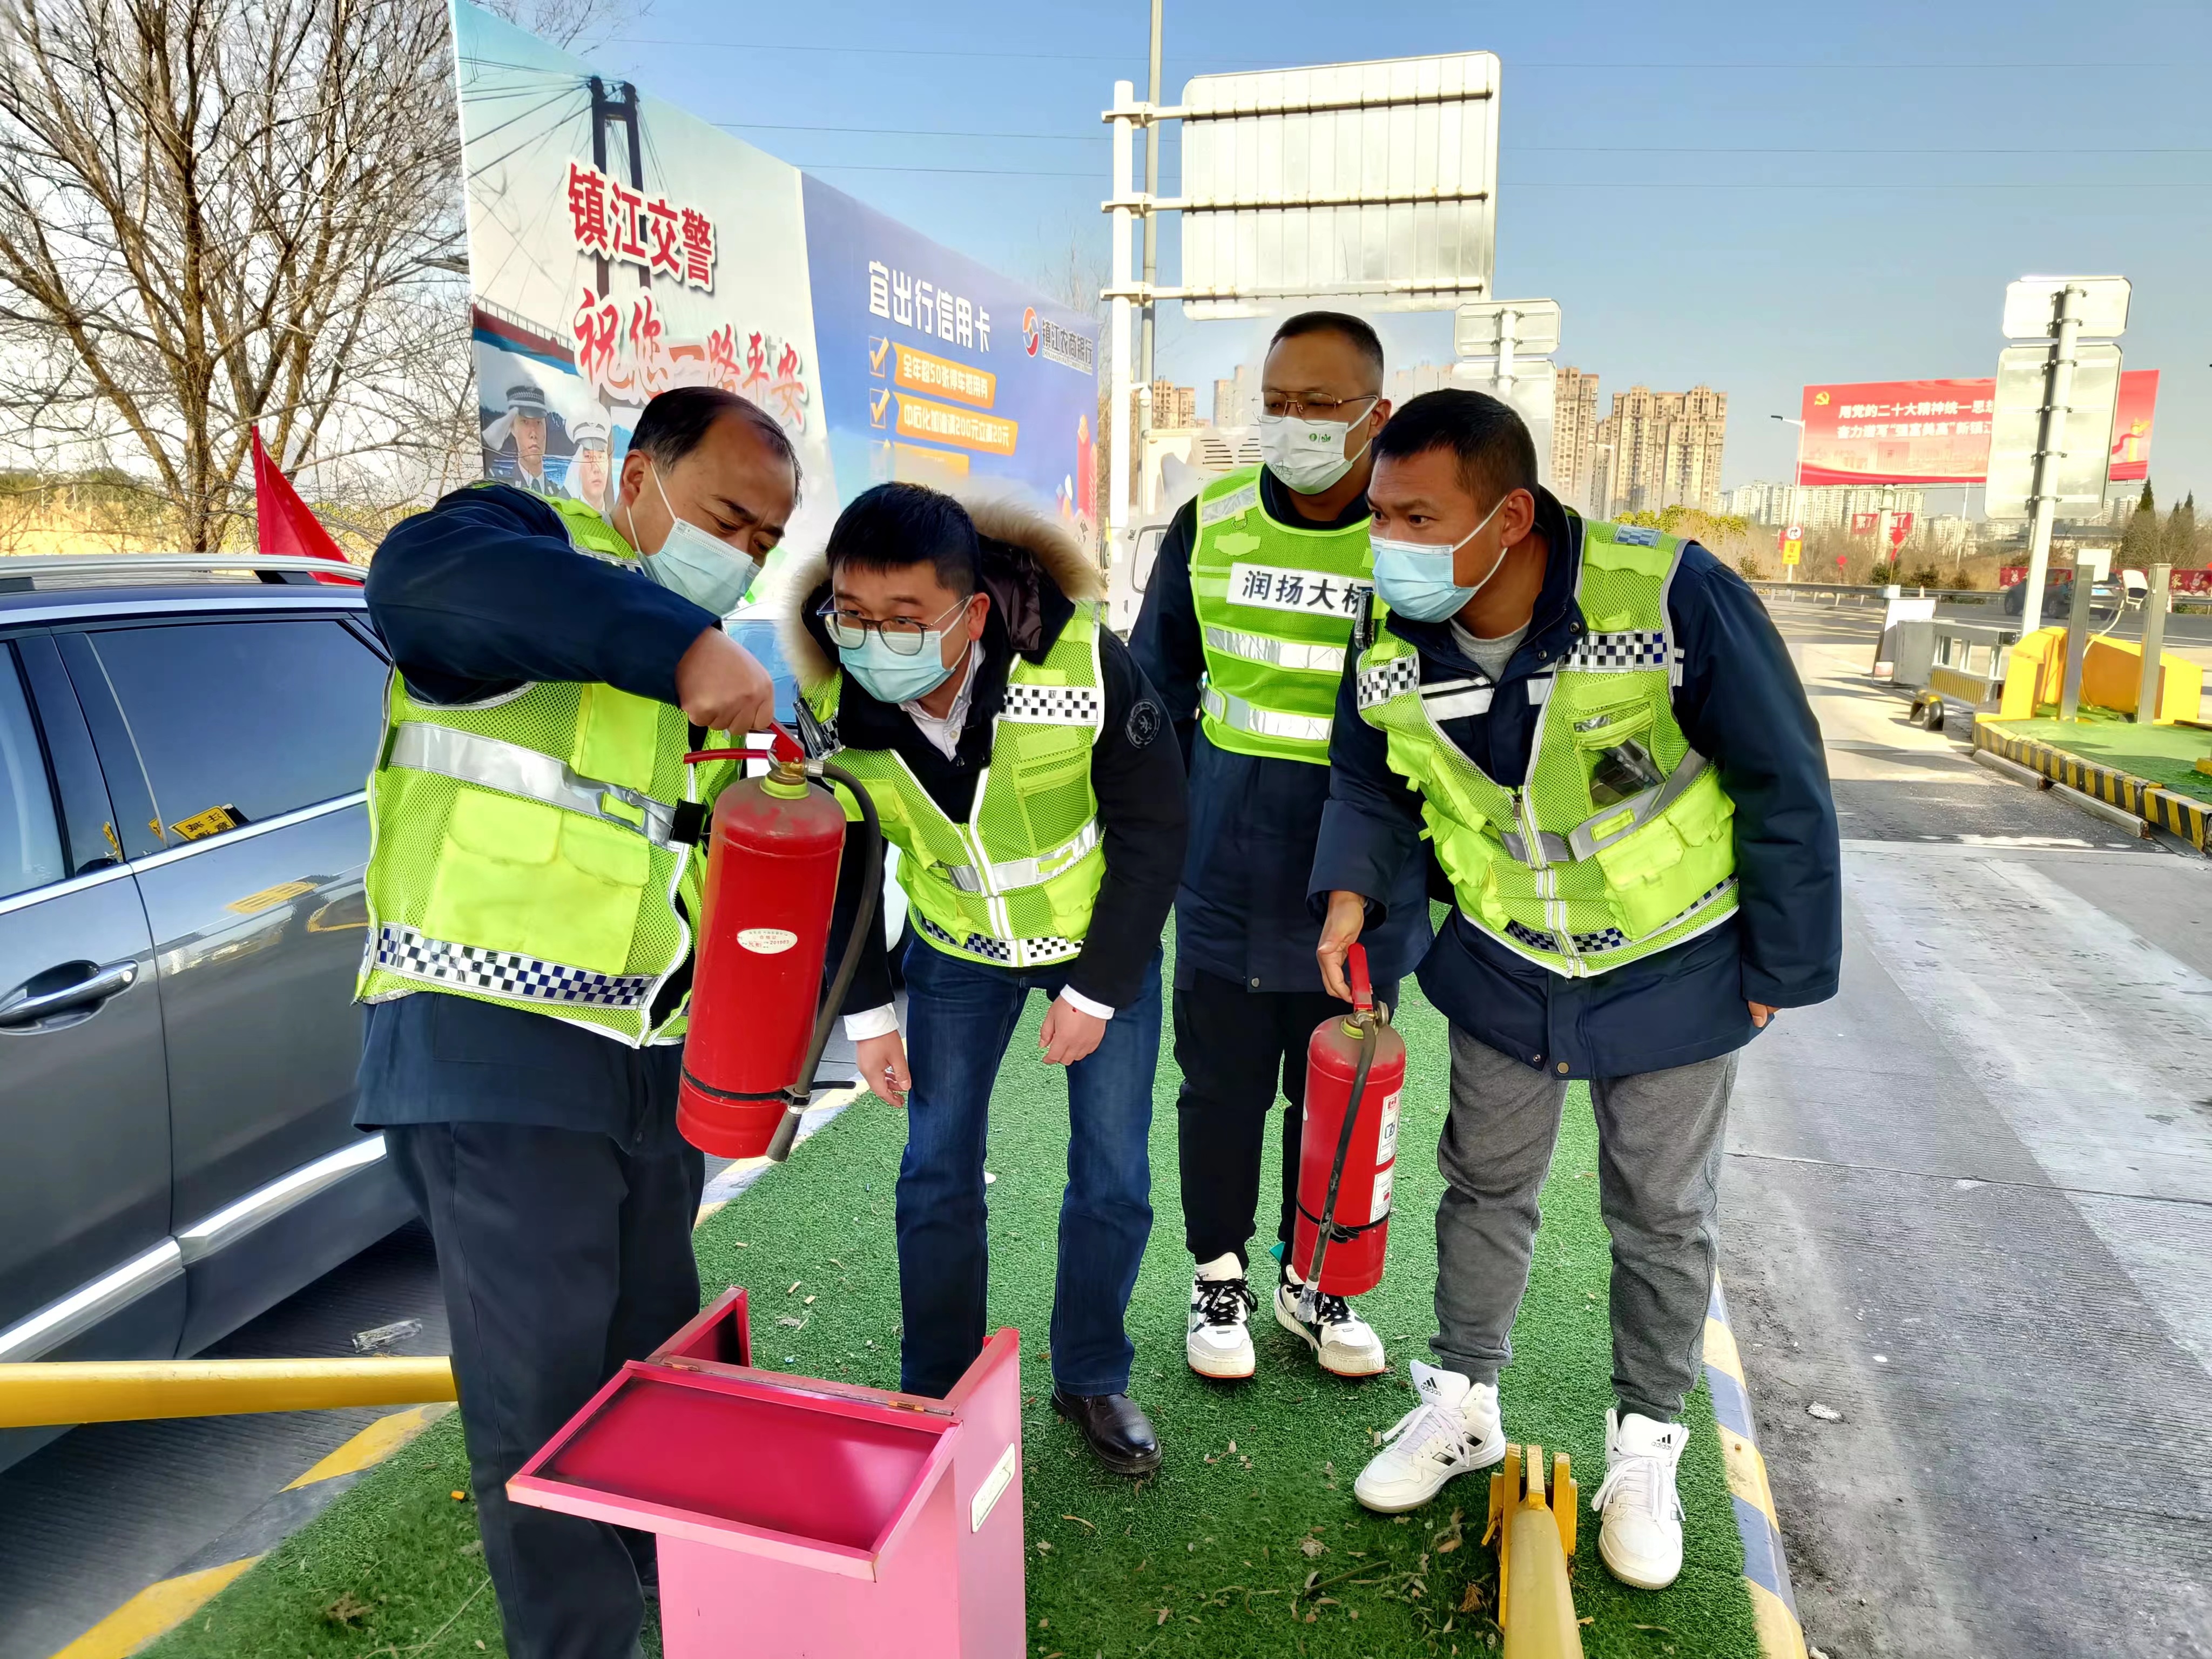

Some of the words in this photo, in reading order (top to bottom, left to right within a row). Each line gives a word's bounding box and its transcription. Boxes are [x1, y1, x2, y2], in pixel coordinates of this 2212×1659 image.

[568, 161, 713, 286] 镇江交警
[868, 260, 990, 353] 宜出行信用卡
[1042, 319, 1092, 365] 镇江农商银行
[1420, 1385, 1442, 1397] adidas
[1651, 1441, 1672, 1451] adidas
